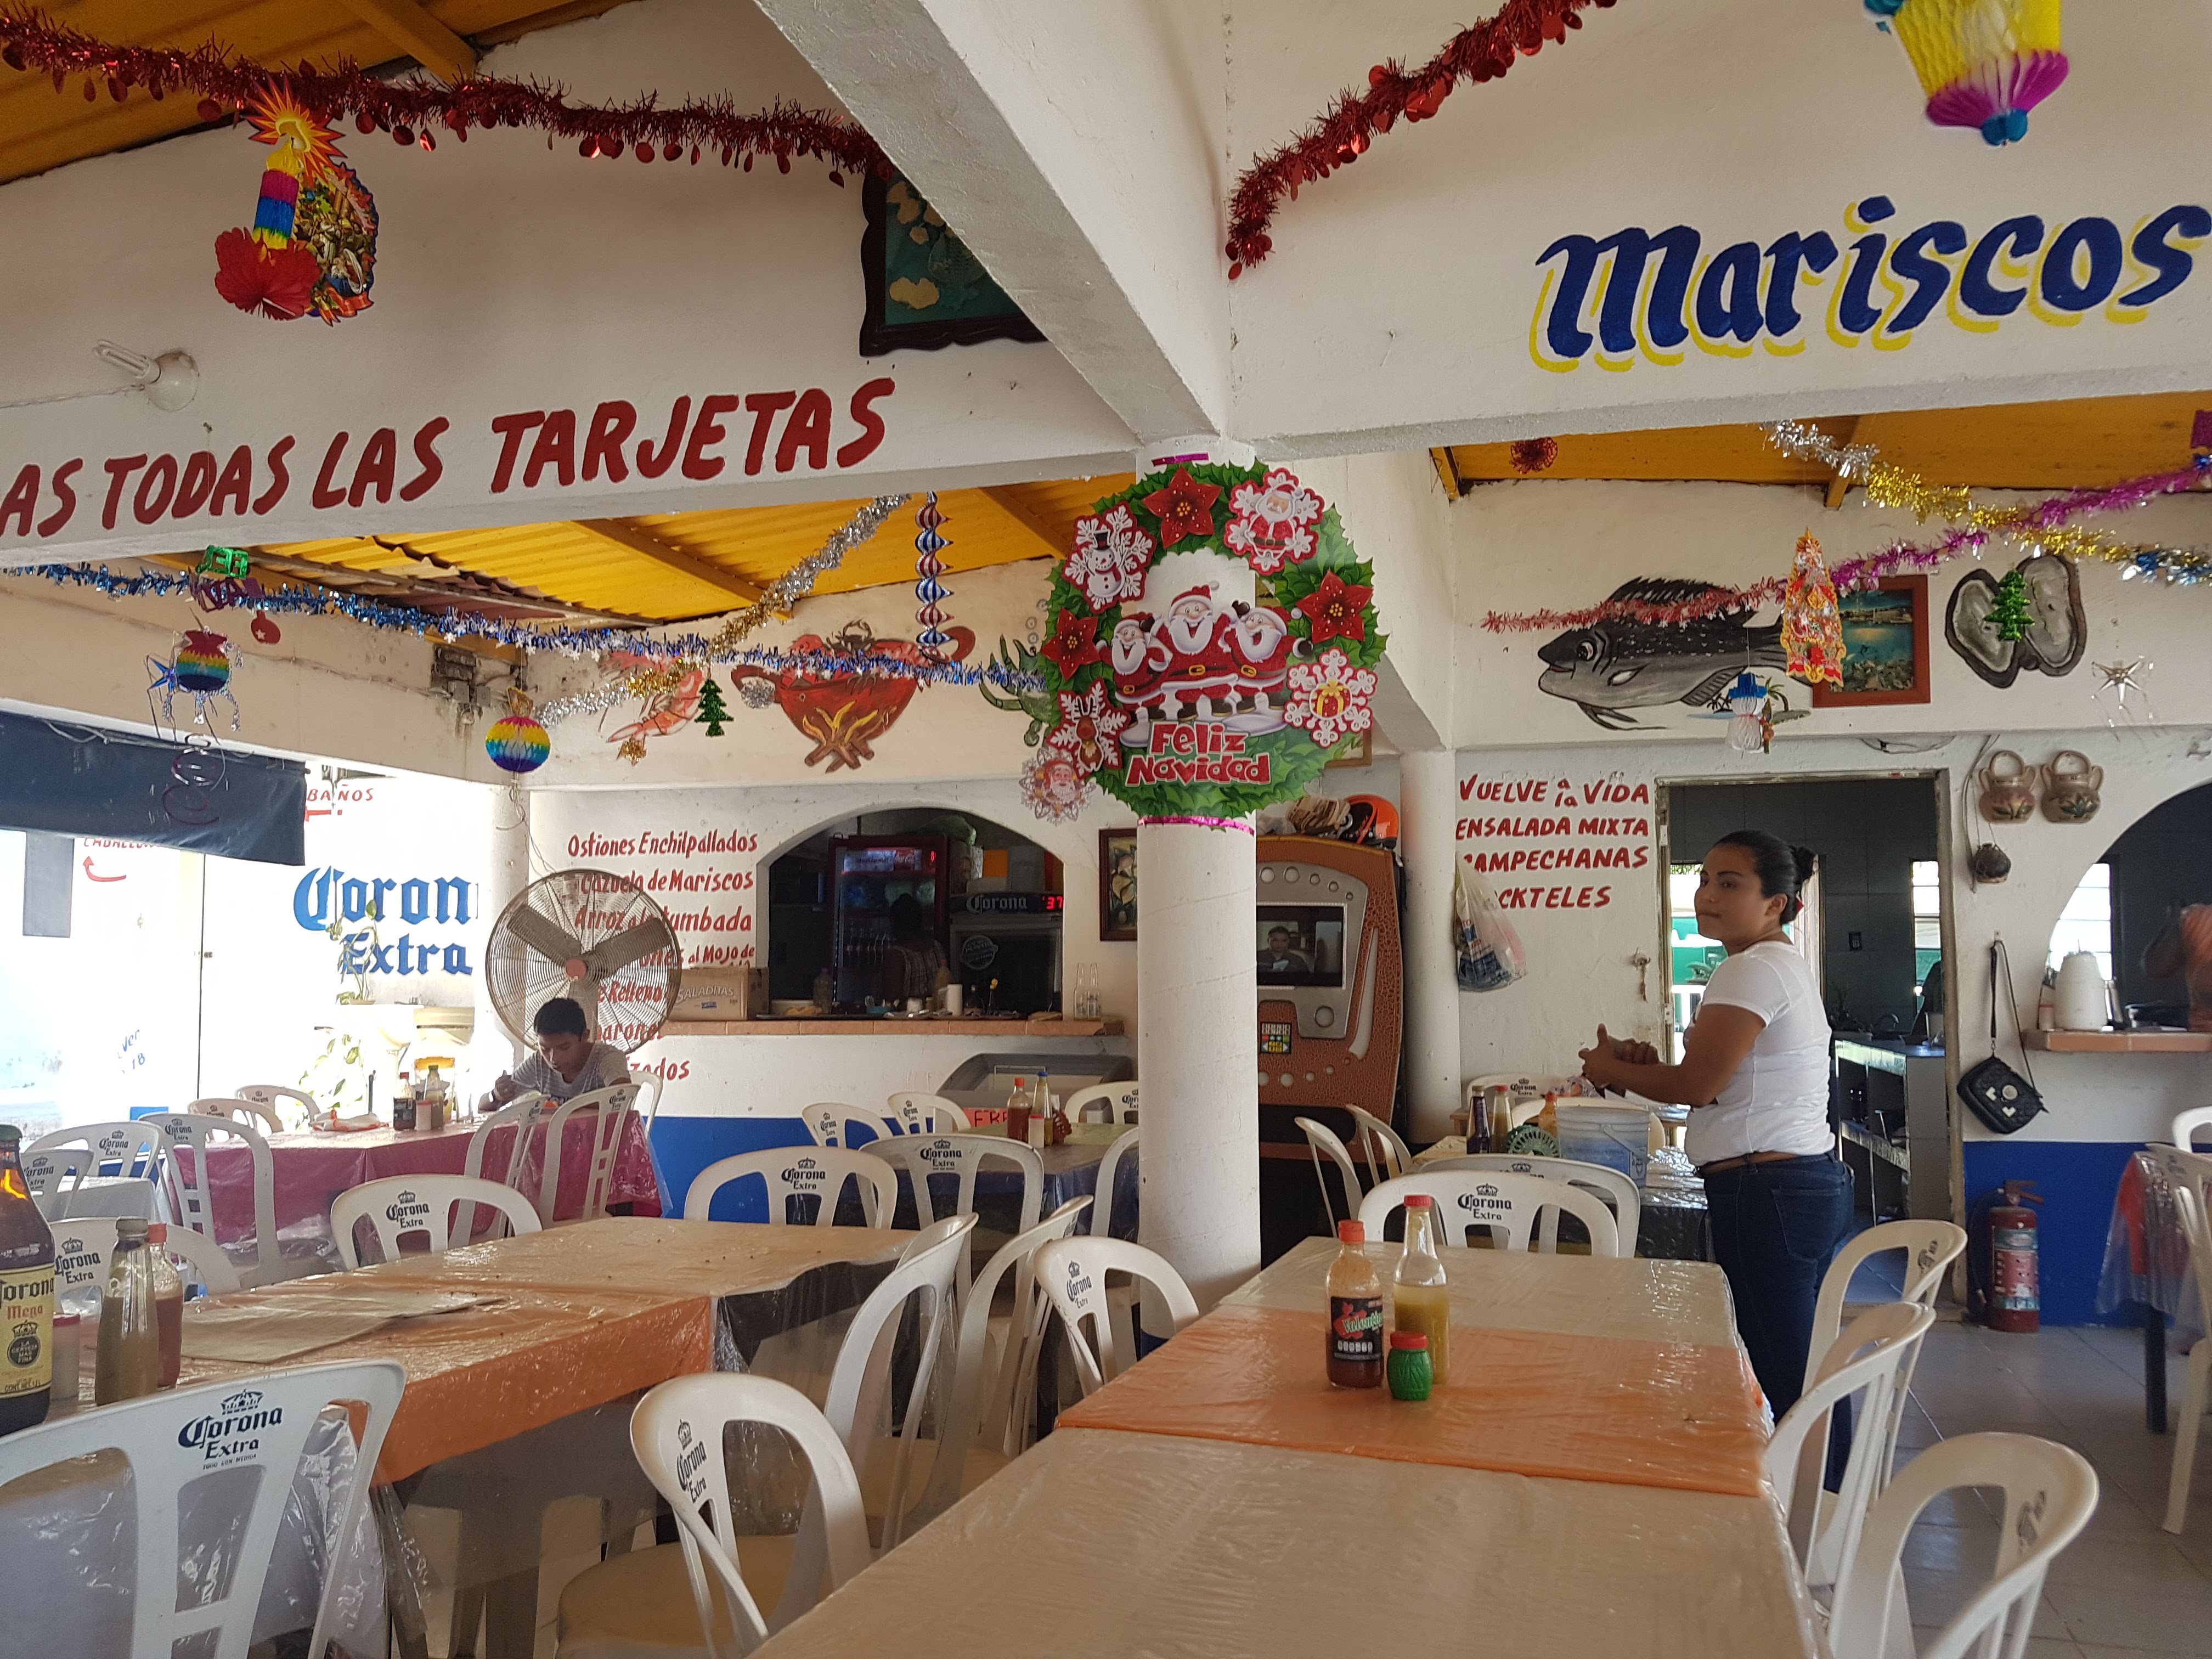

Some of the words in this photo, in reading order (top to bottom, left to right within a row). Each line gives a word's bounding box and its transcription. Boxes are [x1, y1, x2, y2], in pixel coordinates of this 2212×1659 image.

[1534, 196, 2212, 362] Mariscos
[102, 436, 295, 529] TODAS
[312, 416, 449, 508] LAS
[490, 377, 895, 494] TARJETAS
[1150, 721, 1249, 755] Feliz
[1125, 752, 1271, 786] Navidad
[307, 784, 374, 802] BAÑOS
[1459, 774, 1548, 803] VUELVE
[1555, 791, 1578, 808] la
[1583, 780, 1649, 805] VIDA
[1455, 816, 1571, 840] ENSALADA
[1578, 817, 1649, 837] MIXTA
[568, 832, 636, 857] Ostiones
[639, 828, 758, 859] Enchilpallados
[669, 867, 754, 893] Mariscos
[294, 866, 478, 937] Coron
[966, 894, 1028, 915] Corona
[1498, 885, 1612, 910] CKTELES
[338, 933, 473, 977] Extra
[675, 985, 734, 1004] SALADITAS
[920, 1148, 962, 1162] Corona
[781, 1167, 826, 1184] Corona
[386, 1203, 430, 1223] Corona
[1458, 1193, 1512, 1211] Corona
[178, 1407, 283, 1449] Corona
[205, 1438, 259, 1460] Extra
[676, 1441, 707, 1492] Corona
